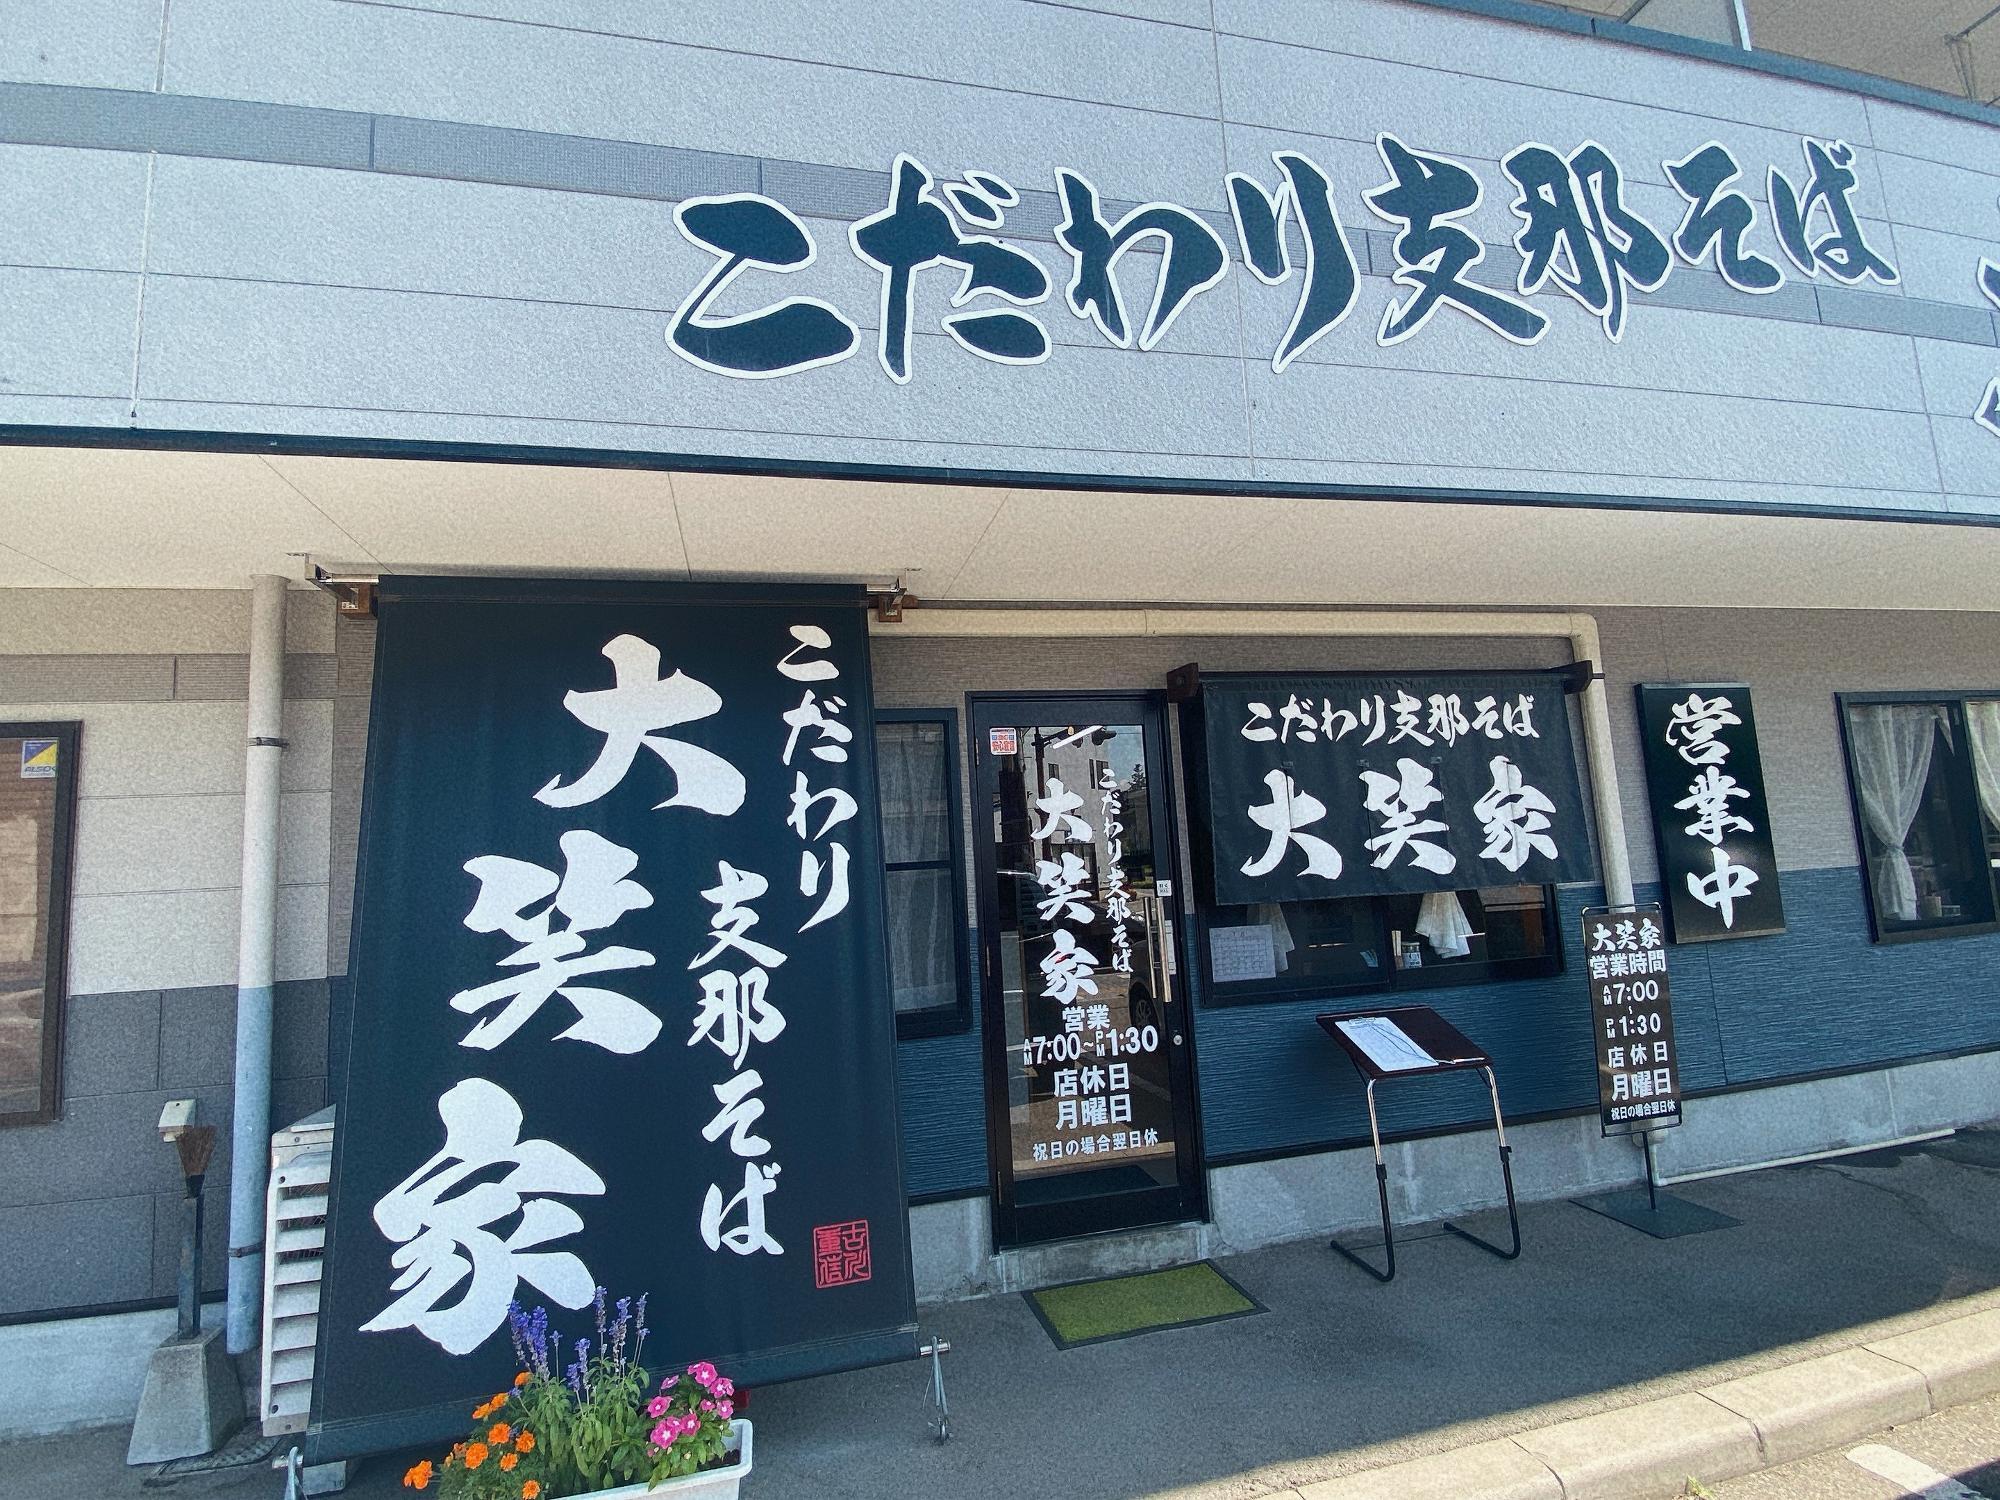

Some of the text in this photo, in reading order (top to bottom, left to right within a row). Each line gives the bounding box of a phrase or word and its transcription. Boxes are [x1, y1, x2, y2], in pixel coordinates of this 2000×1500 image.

[664, 131, 1900, 383] こだわり支那そば
[1240, 689, 1540, 748] こだわり支那そば
[776, 625, 859, 934] こだわり
[1240, 755, 1559, 881] 大笑家
[1665, 692, 1760, 929] 営業中
[1031, 777, 1099, 1005] 大笑家
[1098, 768, 1134, 973] こだわり支那そば
[1592, 918, 1661, 952] 大笑家
[1589, 949, 1667, 980] 営業時間
[358, 633, 748, 1356] 大笑家
[1062, 1004, 1111, 1033] 営業
[687, 860, 788, 1256] 支那そば
[1607, 1041, 1668, 1069] 店休日
[1053, 1062, 1130, 1097] 店休日
[1611, 1068, 1672, 1101] 月曜日
[1055, 1093, 1132, 1131] 月曜日
[1611, 1100, 1676, 1121] 祝日の場合翌日休
[1033, 1127, 1159, 1162] 祝日の場合翌日休
